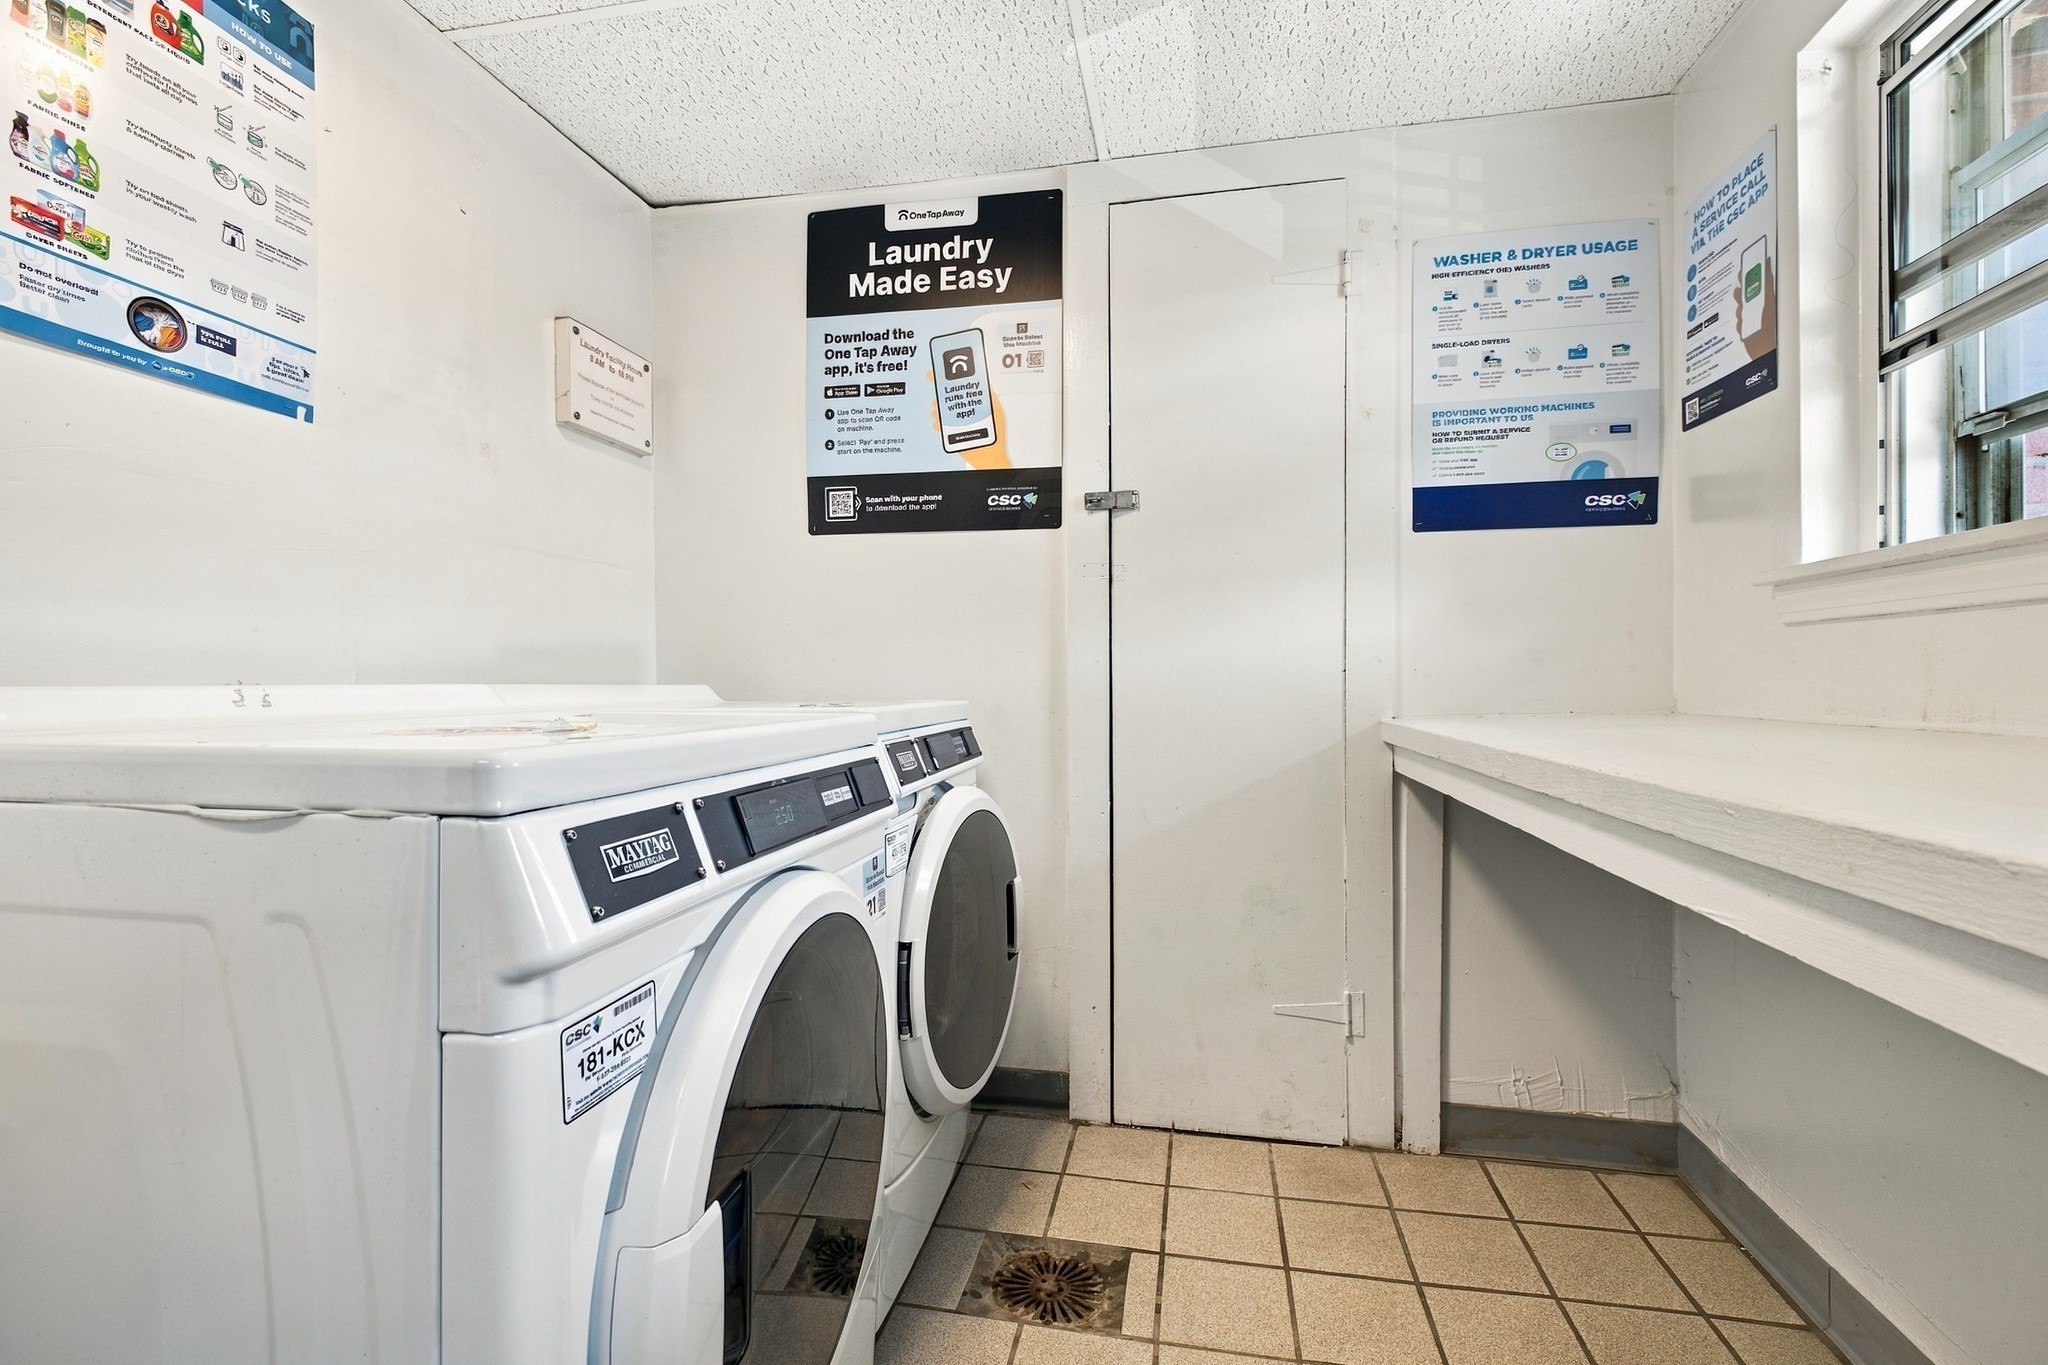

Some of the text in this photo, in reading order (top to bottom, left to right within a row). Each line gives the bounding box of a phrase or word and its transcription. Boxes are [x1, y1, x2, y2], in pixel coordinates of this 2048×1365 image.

[87, 0, 133, 29] DETERGENT
[133, 28, 154, 43] PACS
[167, 47, 191, 65] LIQUID
[231, 22, 293, 70] HOW TO USE
[126, 53, 198, 99] Try your
[126, 61, 199, 106] clothes freshness
[126, 67, 184, 104] that day
[27, 99, 86, 132] FABRIC RINSE
[126, 119, 196, 160] Try musty towels
[133, 131, 186, 161] sweaty clothes
[19, 162, 96, 200] FABRIC SOFTENER
[1693, 152, 1765, 224] HOW TO PLACE
[125, 179, 189, 214] Try bed sheets
[135, 192, 198, 224] your weekly wash
[1691, 169, 1767, 240] A SERVICE CALL
[1690, 182, 1769, 255] VIA THE CSC APP
[25, 231, 89, 260] DRYER SHEETS
[125, 239, 175, 263] Try protect
[868, 234, 994, 267] Laundry
[1433, 239, 1639, 268] WASHER & DRYER USAGE
[126, 246, 172, 269] clothes from
[126, 252, 186, 280] heat dryer
[1496, 265, 1512, 275] (HE)
[1514, 263, 1551, 272] WASHERS
[19, 262, 99, 296] Do not overload!
[19, 274, 87, 302] Faster dry times
[849, 265, 1013, 298] Made Easy
[19, 280, 71, 304] Better clean
[208, 338, 225, 349] FULL
[215, 334, 232, 345] FULL
[824, 328, 915, 344] Download the
[1015, 340, 1041, 348] Machine
[1431, 338, 1511, 350] SINGLE-LOAD DRYERS
[77, 338, 111, 356] Brought
[122, 353, 137, 364] you
[137, 357, 148, 366] by
[580, 338, 643, 378] Laundry Facility Hours
[824, 345, 917, 360] One Tap Away
[1002, 353, 1022, 369] 01
[595, 357, 605, 369] AM
[609, 364, 616, 374] to
[625, 374, 635, 383] PM
[824, 360, 908, 378] app, it's free!
[1745, 372, 1762, 386] CSC
[944, 380, 980, 394] Laundry
[944, 389, 983, 403] runs free
[878, 407, 895, 415] Away
[947, 397, 983, 412] with the
[956, 408, 976, 420] app!
[1432, 401, 1595, 419] PROVIDING WORKING MACHINES
[846, 424, 874, 432] machine.
[1432, 413, 1534, 427] IS IMPORTANT TO US
[1499, 426, 1531, 434] SERVICE
[837, 439, 857, 447] Select
[887, 438, 905, 446] press
[874, 446, 903, 454] machine.
[1444, 436, 1474, 444] REFUND
[866, 496, 883, 504] Scan
[901, 495, 918, 504] your
[919, 493, 943, 503] phone
[875, 503, 908, 512] download
[921, 502, 937, 511] app!
[987, 494, 1022, 506] CSC
[1584, 494, 1627, 506] CSC
[605, 833, 672, 869] MAYTAG
[623, 853, 667, 874] COMMERCIAL
[866, 895, 876, 917] 21
[565, 1023, 592, 1046] CSC
[577, 1019, 646, 1079] 181-KCX
